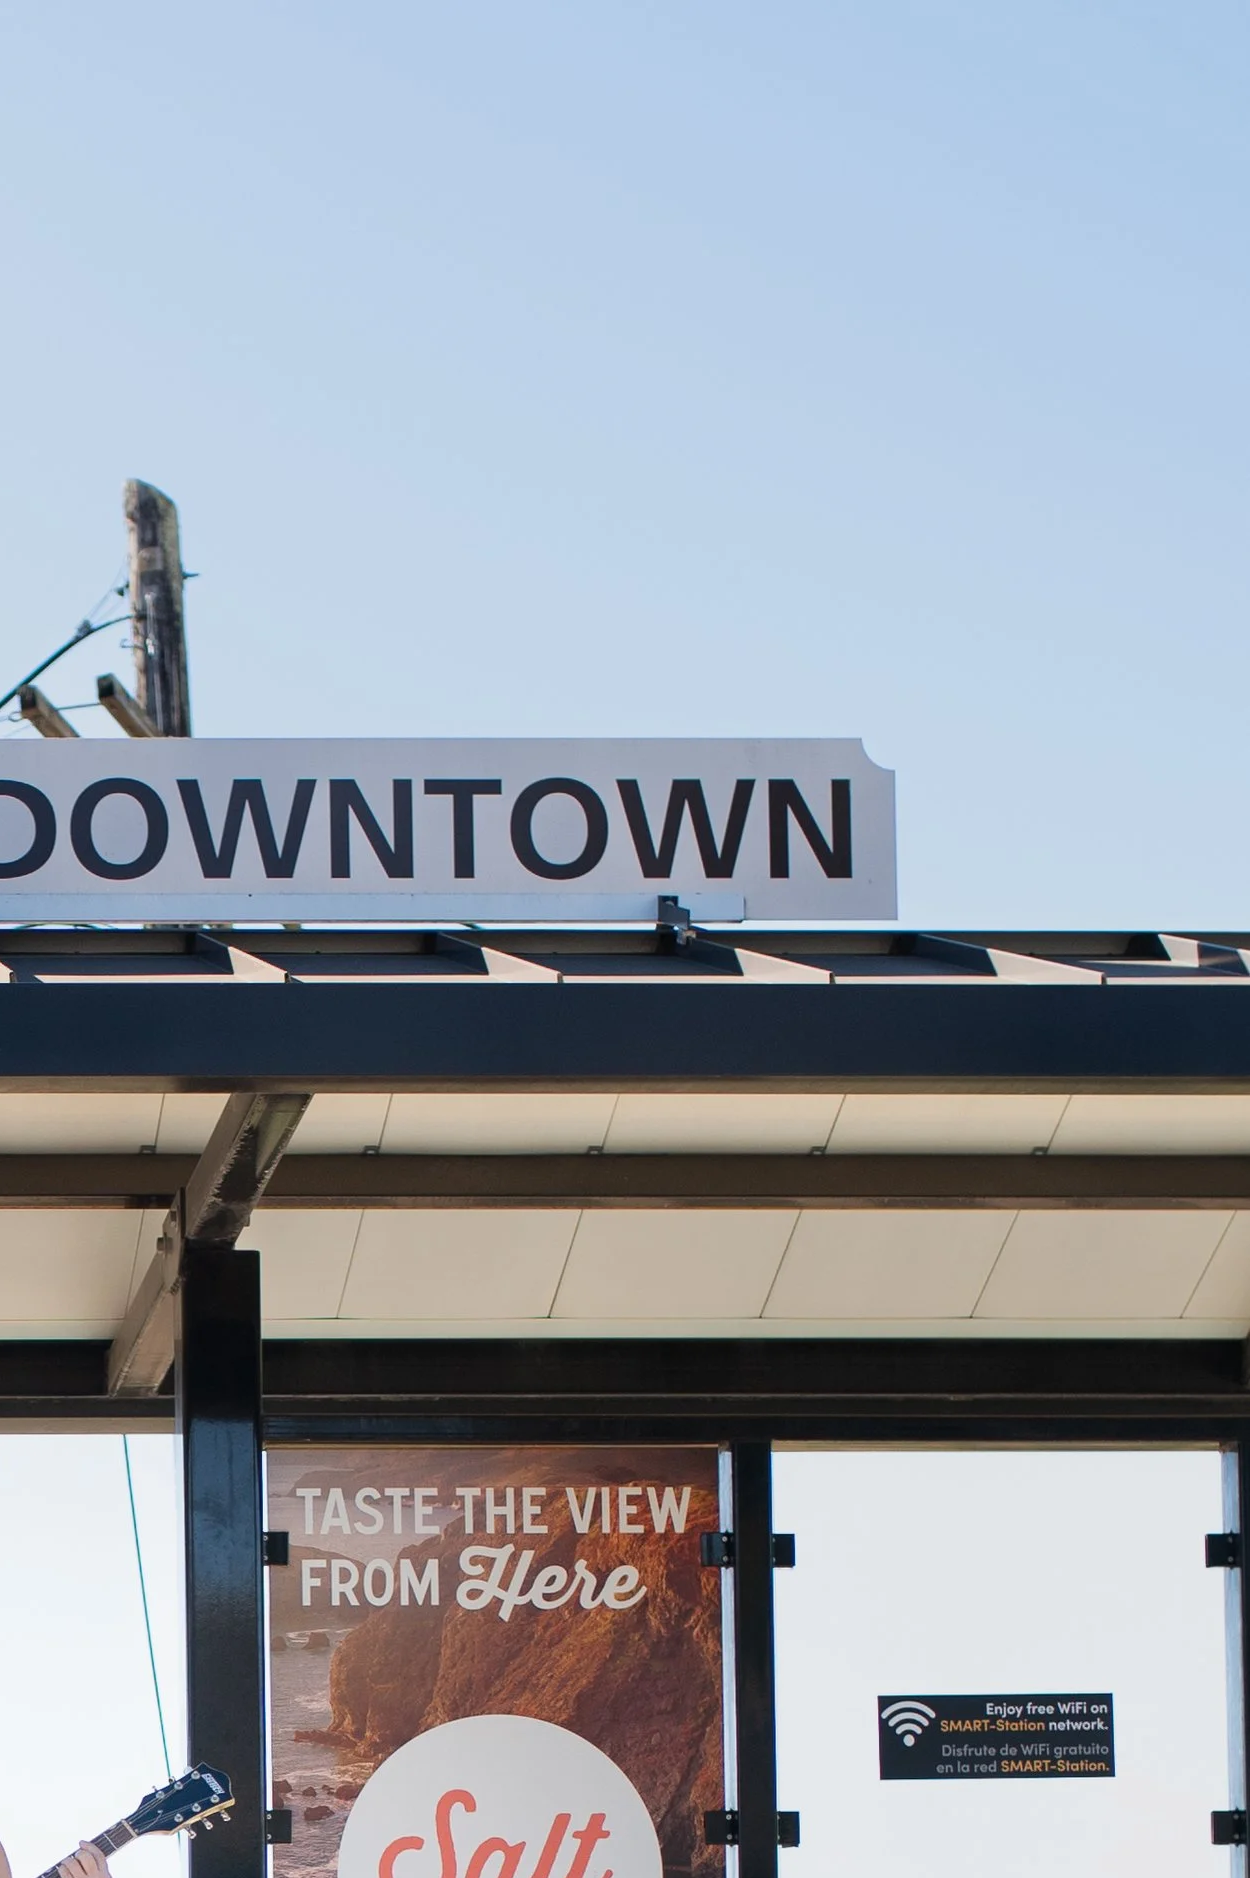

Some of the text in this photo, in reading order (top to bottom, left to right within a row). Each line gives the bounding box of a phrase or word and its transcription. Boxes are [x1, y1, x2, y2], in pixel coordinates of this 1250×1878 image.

[296, 1486, 692, 1535] TASTE THE VIEW
[301, 1543, 648, 1623] FROM Here
[986, 1702, 1108, 1718] Enjoy free WiFi on
[940, 1717, 1109, 1732] SMART-Station network.
[942, 1742, 1109, 1758] Disfrute de WiFi gratuito
[936, 1759, 1110, 1773] en la red SMART-Station.
